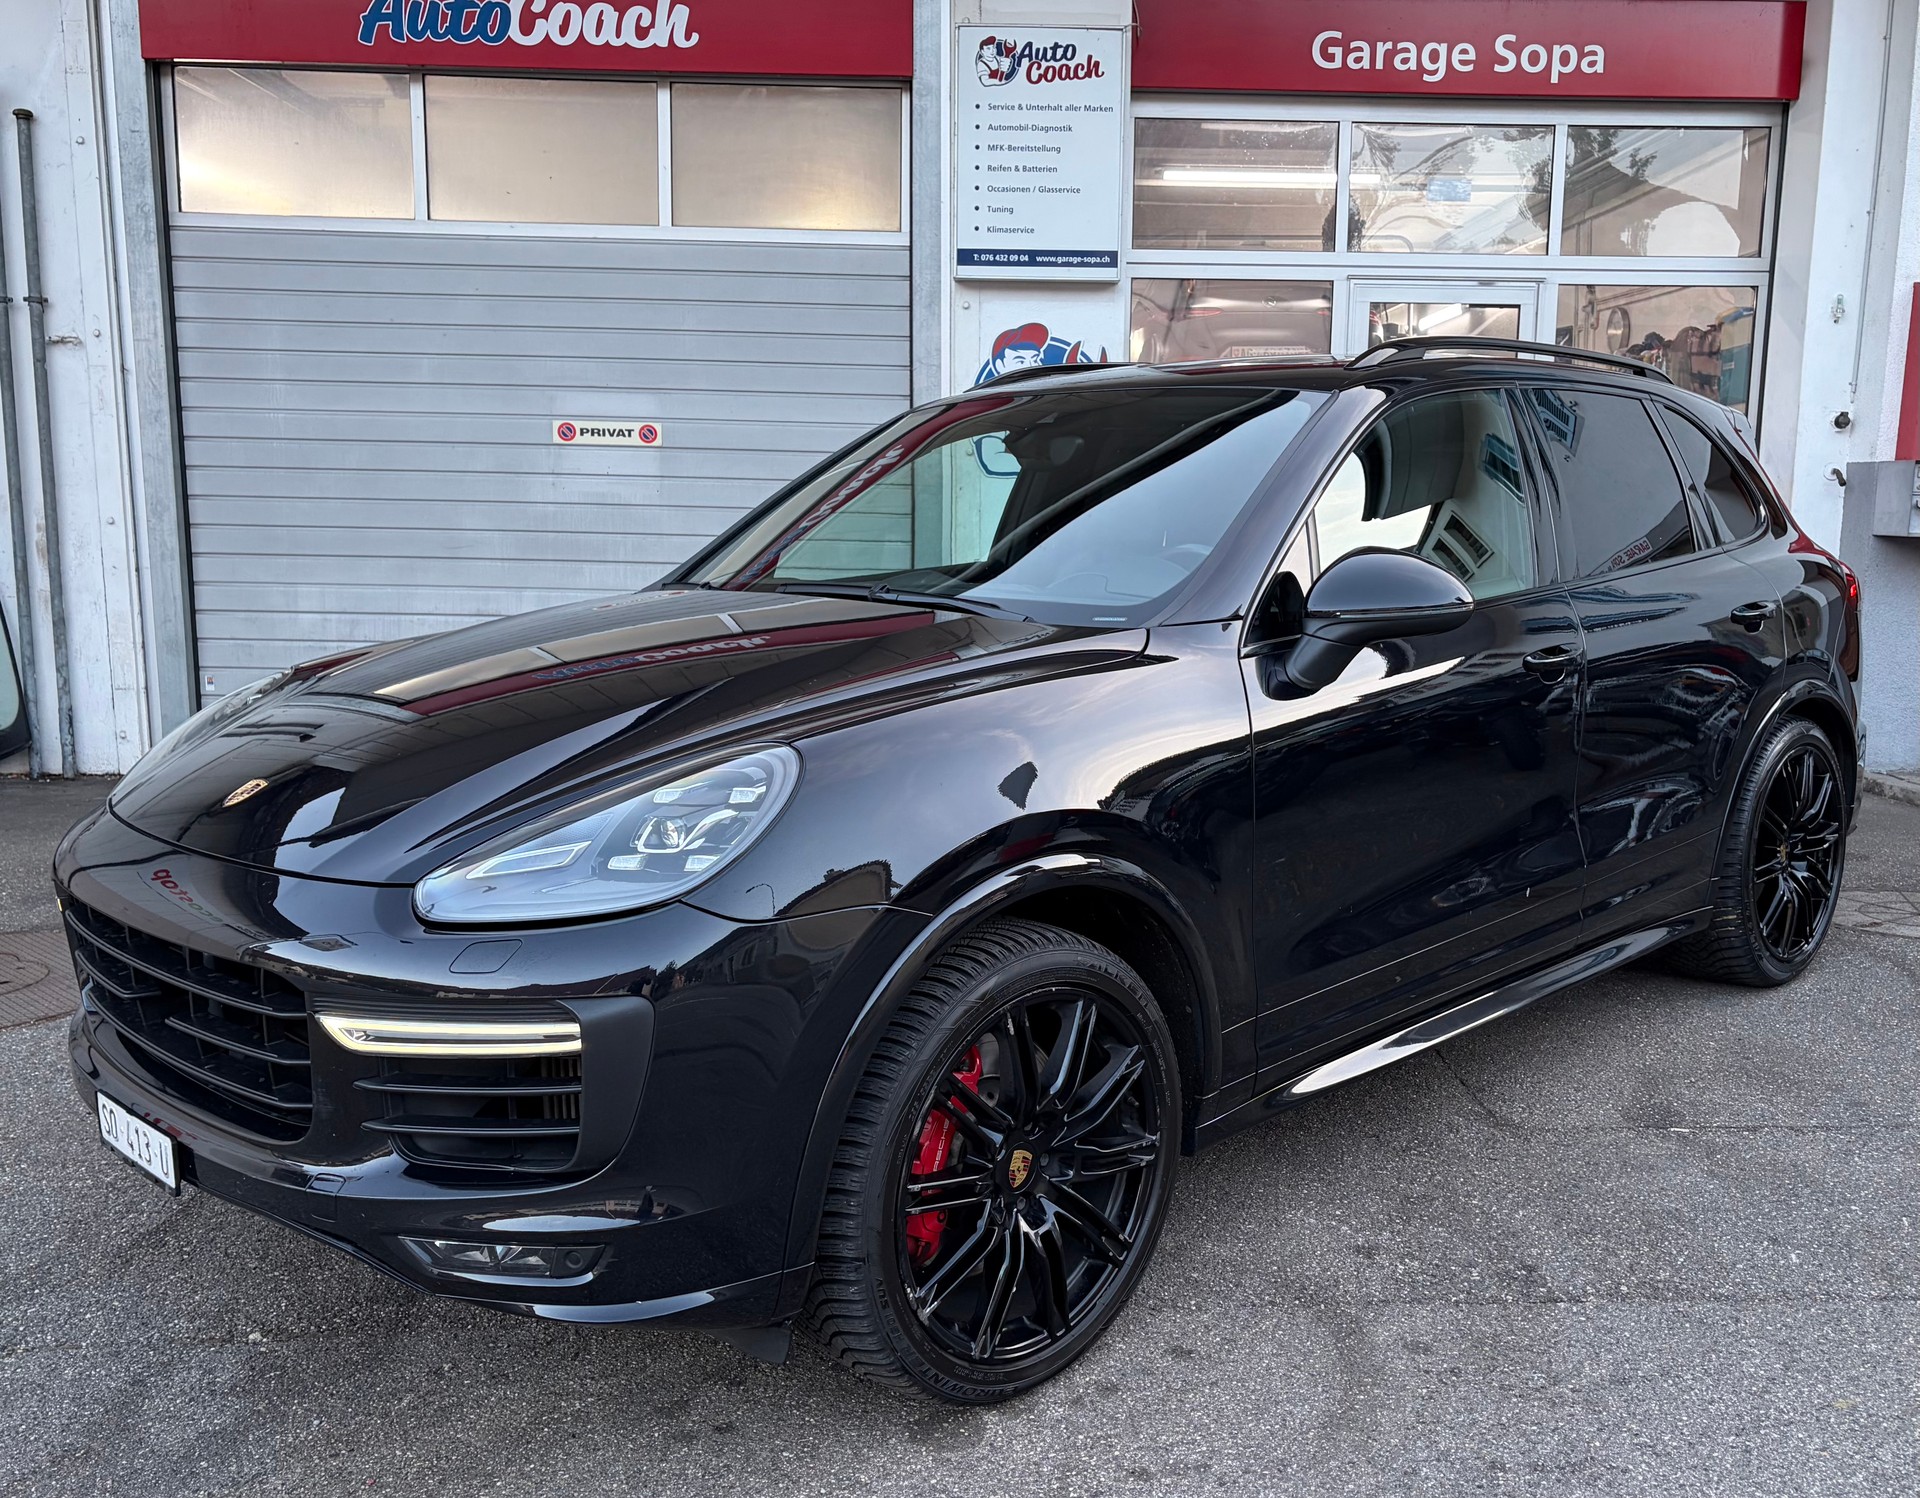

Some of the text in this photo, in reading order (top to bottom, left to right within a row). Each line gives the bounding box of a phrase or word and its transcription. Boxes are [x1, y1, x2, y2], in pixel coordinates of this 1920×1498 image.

[357, 0, 699, 47] AutoCoach
[1016, 41, 1077, 68] Auto
[1311, 30, 1605, 84] Garage Sopa
[1025, 54, 1105, 85] Coach
[987, 103, 1114, 113] Service & Unterhalt aller Marken
[987, 123, 1073, 133] Automobil-Diagnostik
[987, 144, 1062, 154] MFK-Bereitstellung
[987, 164, 1058, 173] Reifen & Batterien
[987, 185, 1031, 193] Occasionen
[1038, 185, 1081, 194] Glasservice
[987, 205, 1014, 215] Tuning
[986, 226, 1035, 234] Klimaservice
[995, 254, 1008, 262] 432
[1009, 254, 1019, 262] 09
[1036, 255, 1111, 264] www.garage-sopa.ch
[579, 427, 635, 438] PRIVAT
[102, 1103, 118, 1142] SO
